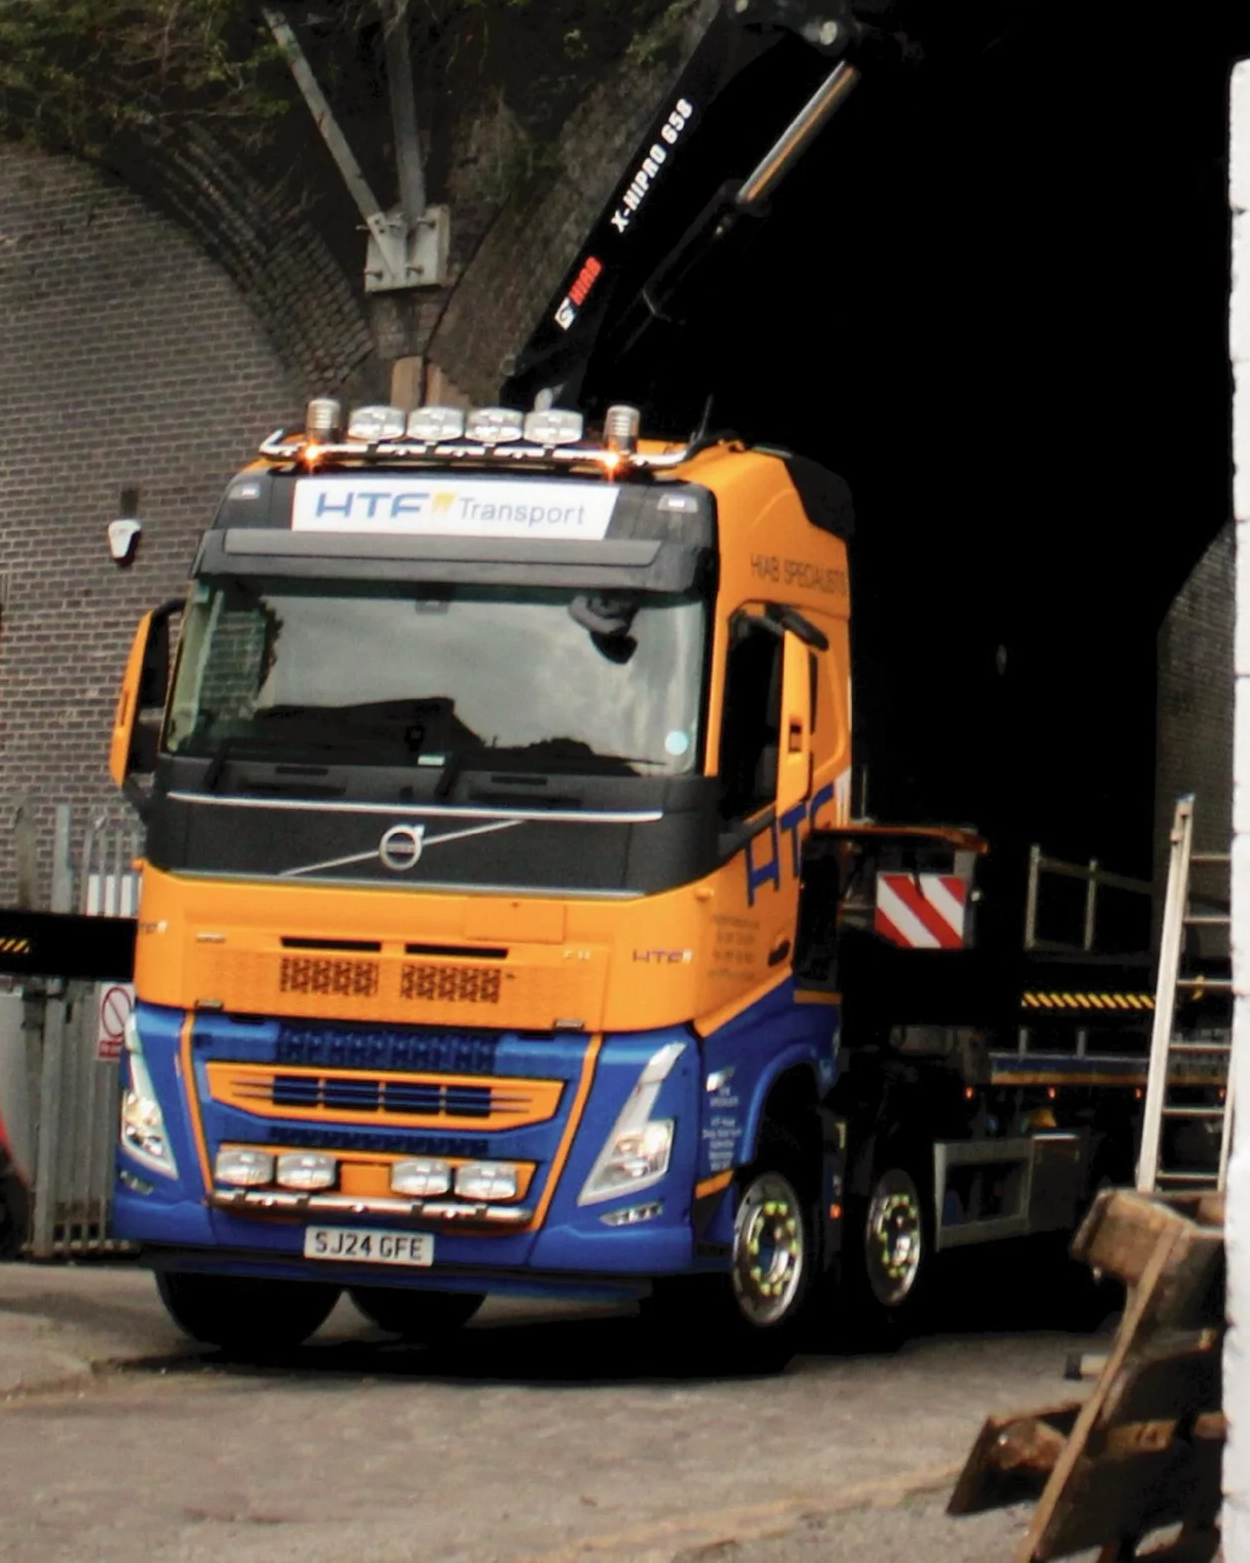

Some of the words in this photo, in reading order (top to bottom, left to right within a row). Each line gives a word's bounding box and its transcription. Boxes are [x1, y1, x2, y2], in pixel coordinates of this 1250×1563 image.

[611, 144, 667, 233] X-HIPRO
[661, 98, 694, 145] 658
[315, 492, 430, 519] HTF
[459, 497, 586, 527] Transport
[314, 1230, 372, 1257] SJ24
[379, 1235, 424, 1261] GFE
